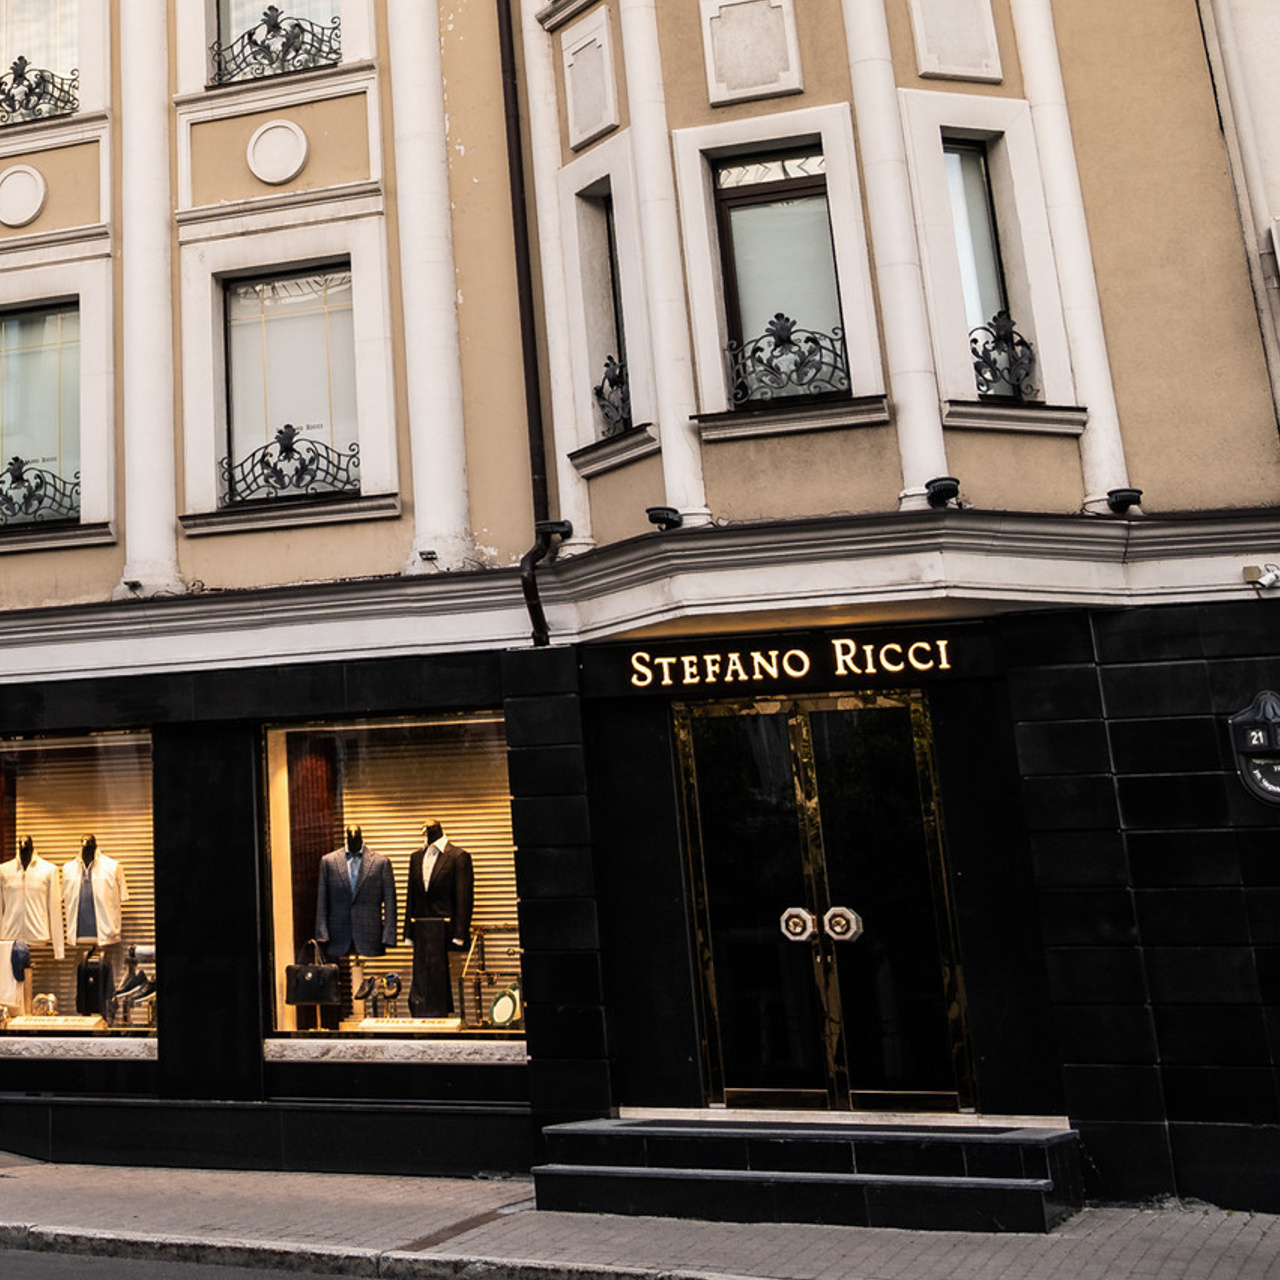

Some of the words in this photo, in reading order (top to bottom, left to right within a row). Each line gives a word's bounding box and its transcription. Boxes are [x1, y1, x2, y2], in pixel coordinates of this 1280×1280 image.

[630, 648, 811, 688] STEFANO
[831, 638, 952, 676] RICCI
[1250, 730, 1264, 745] 21
